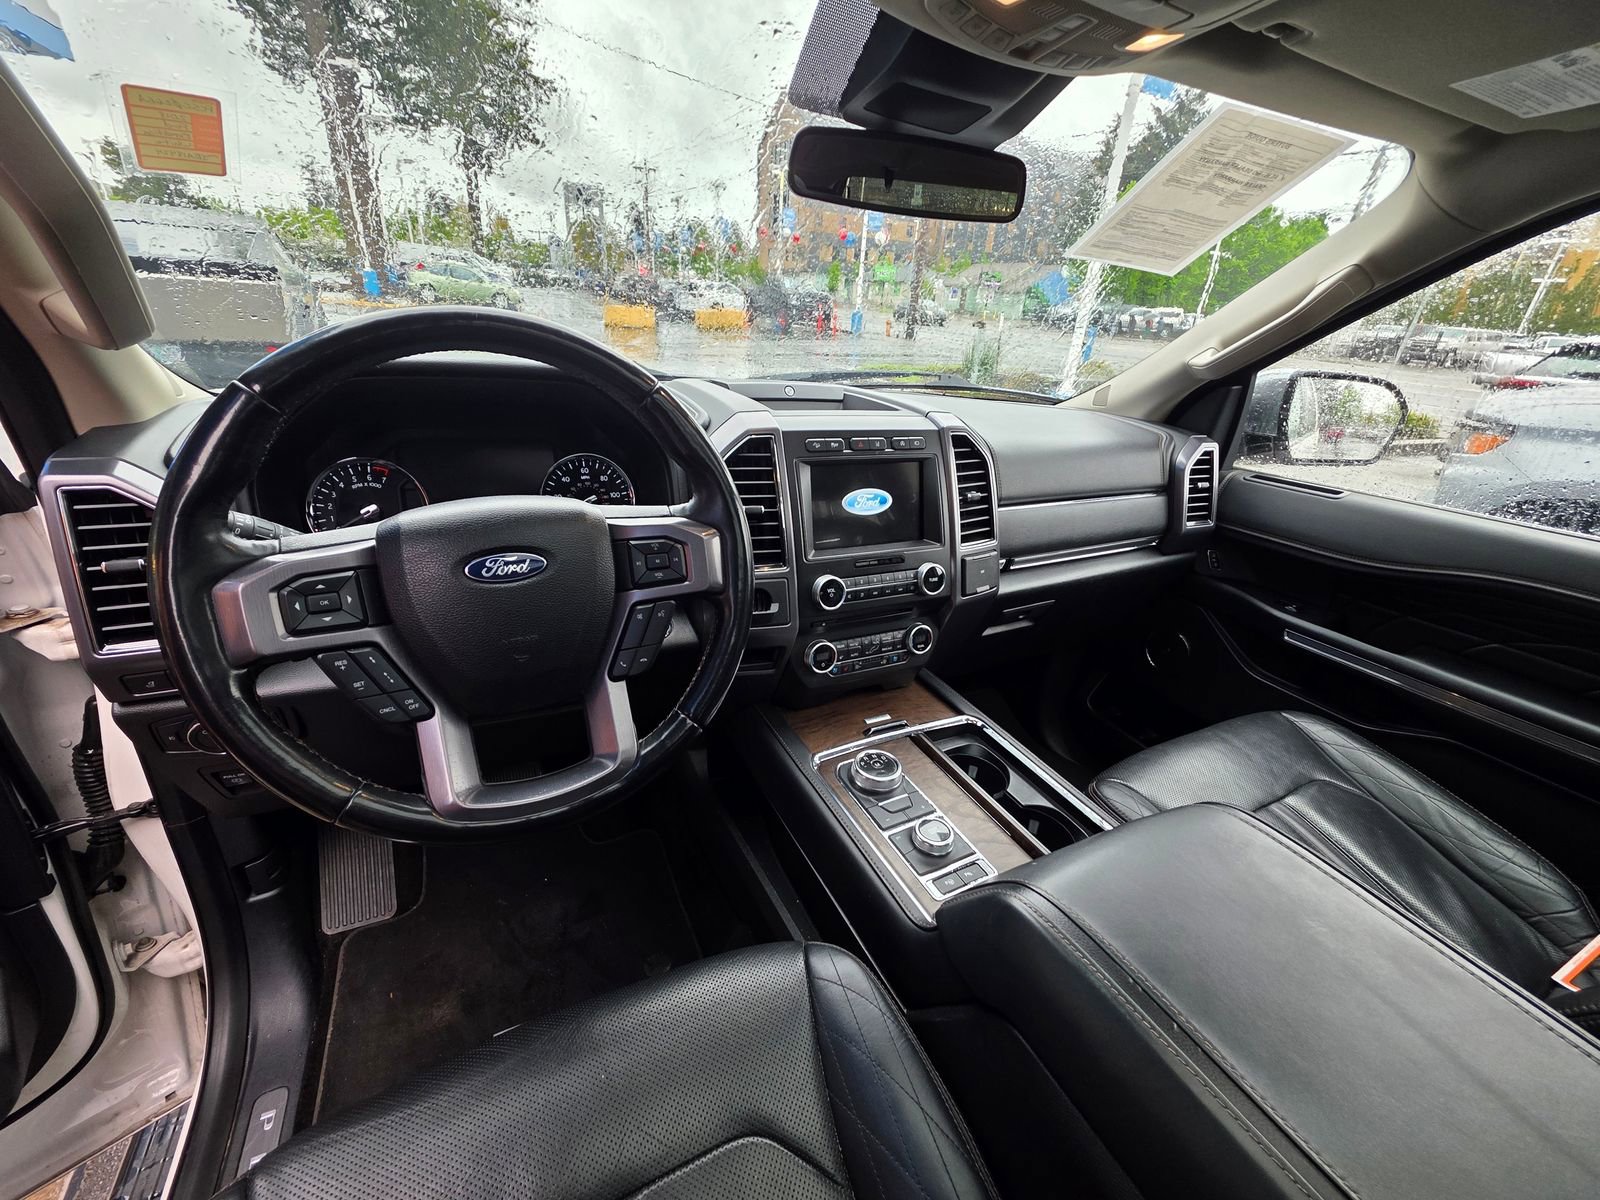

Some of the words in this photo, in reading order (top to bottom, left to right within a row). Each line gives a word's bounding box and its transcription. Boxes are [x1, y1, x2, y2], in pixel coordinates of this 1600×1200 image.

[580, 467, 590, 475] 60
[351, 475, 358, 483] 5
[366, 473, 373, 482] 6
[381, 476, 388, 484] 7
[561, 475, 571, 484] 40
[599, 475, 609, 483] 80
[338, 481, 345, 489] 4
[351, 482, 363, 490] RPM
[369, 482, 383, 490] 1000
[331, 490, 337, 498] 3
[609, 491, 621, 499] 100
[853, 493, 881, 509] Ford
[327, 502, 334, 511] 2
[481, 556, 531, 578] Ford
[334, 659, 348, 667] RES
[353, 680, 365, 688] SET
[379, 706, 396, 714] CNCL
[408, 702, 420, 710] OFF
